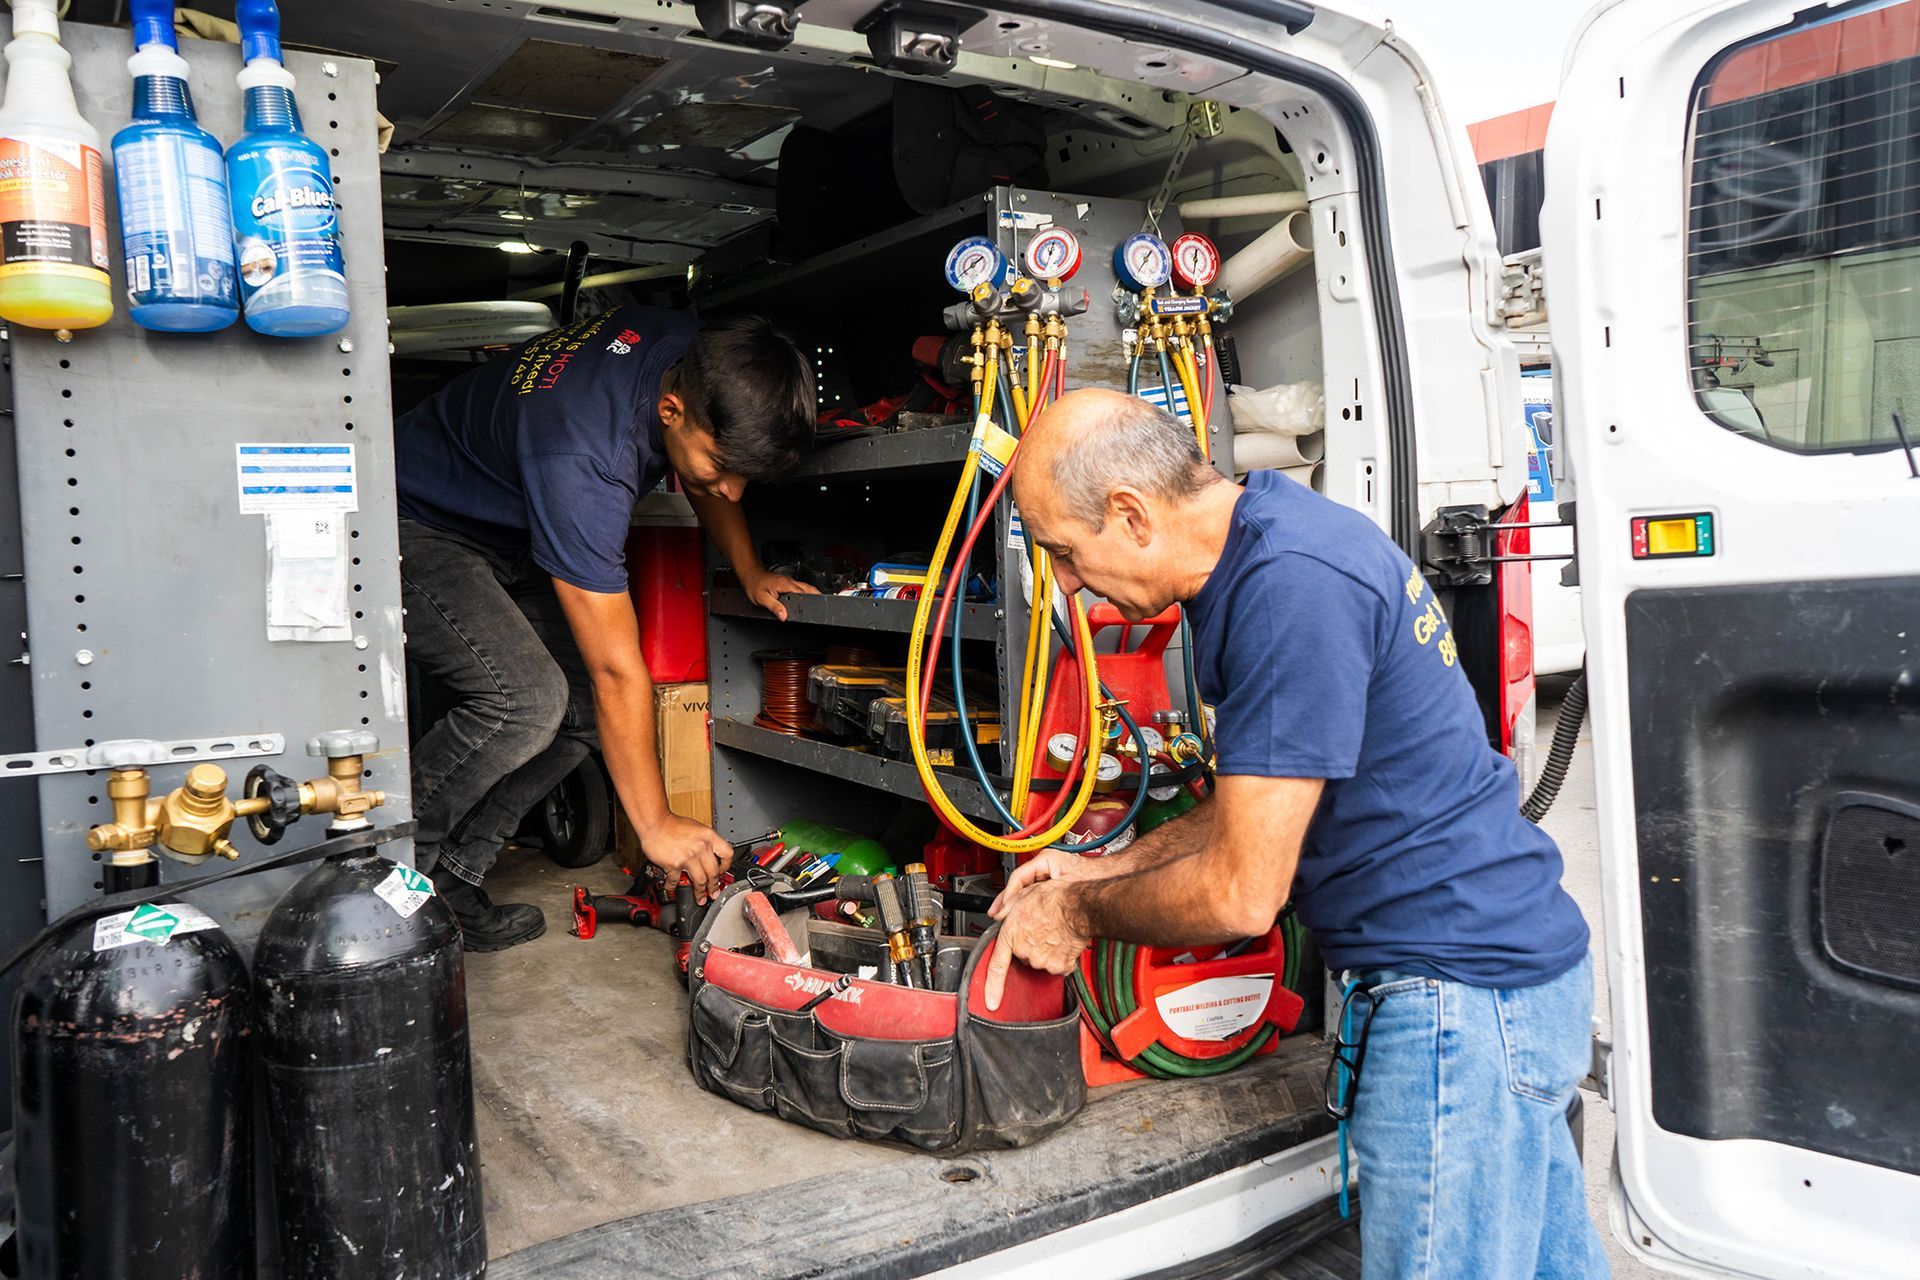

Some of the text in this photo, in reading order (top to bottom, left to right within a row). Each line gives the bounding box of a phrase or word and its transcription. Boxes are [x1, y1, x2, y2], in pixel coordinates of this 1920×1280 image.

[518, 354, 552, 395] fixed!
[538, 353, 575, 389] HOT!
[801, 976, 864, 1007] HUKY
[1169, 1004, 1195, 1014] PORTABLE
[1195, 1001, 1218, 1010] WELDING
[1223, 996, 1244, 1006] CUTTING
[1244, 992, 1261, 1003] OUTFIT
